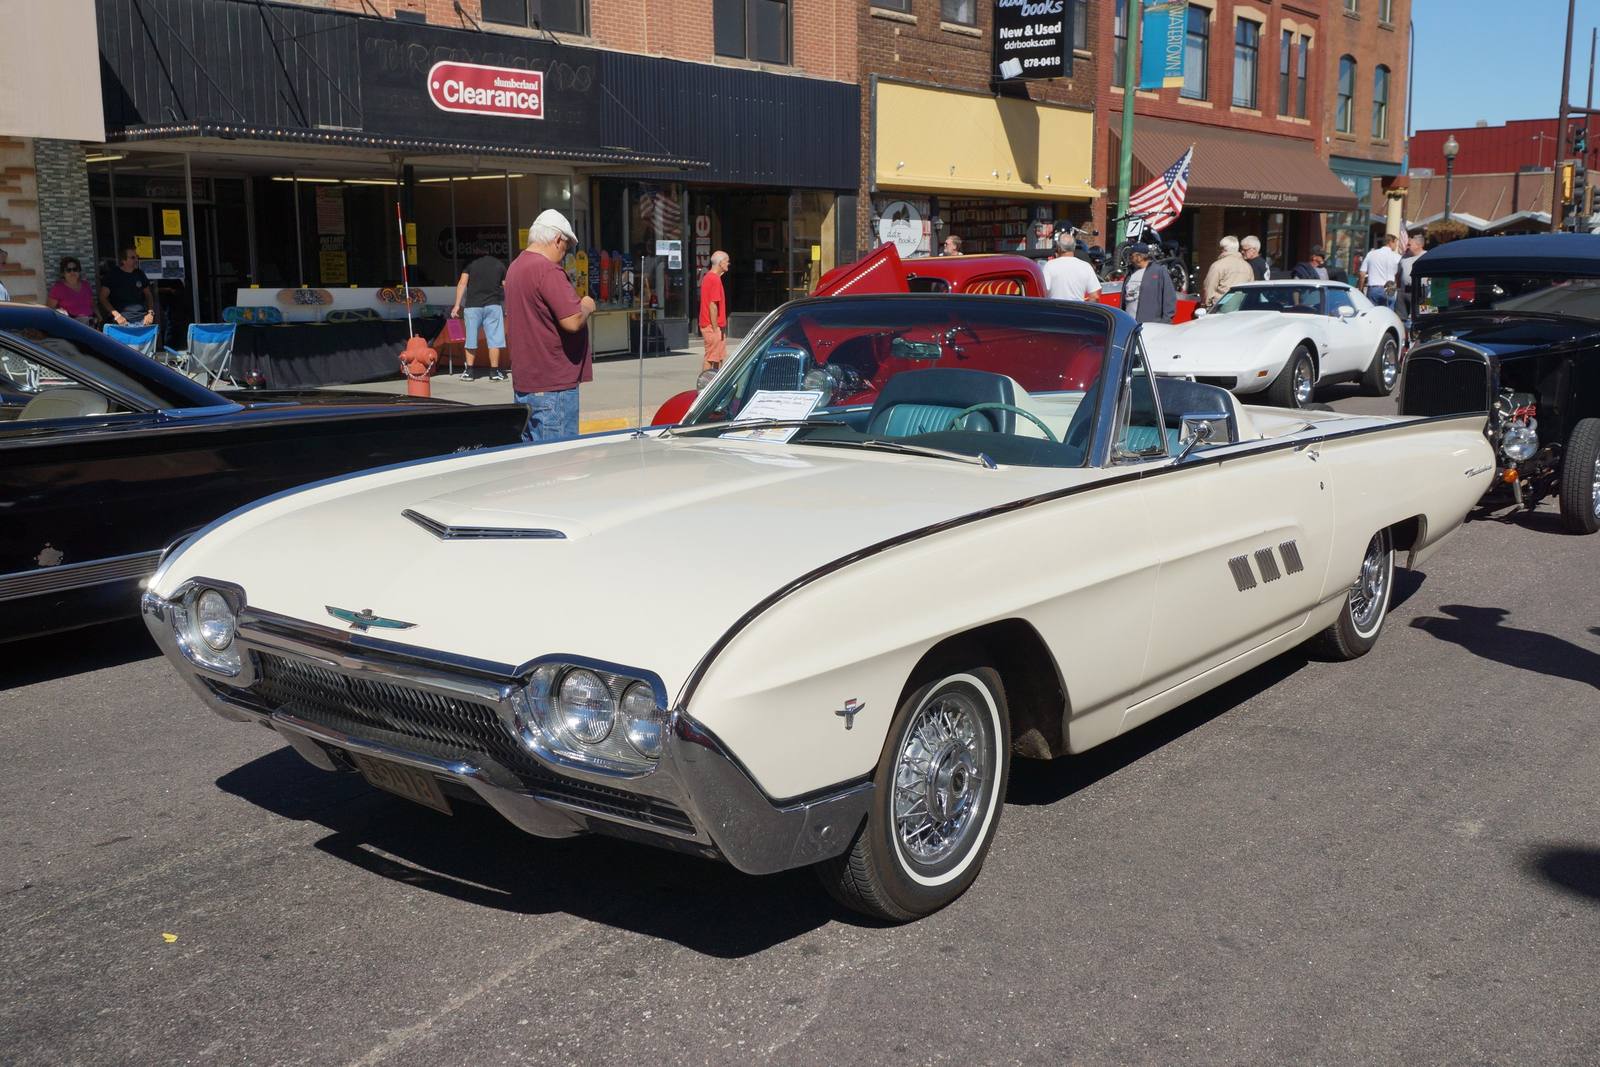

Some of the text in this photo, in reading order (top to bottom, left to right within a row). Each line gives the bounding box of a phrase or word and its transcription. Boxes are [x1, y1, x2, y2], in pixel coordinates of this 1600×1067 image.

[1021, 0, 1063, 16] books
[1000, 21, 1061, 39] New & Used
[1165, 4, 1184, 70] WATERTOWN
[1004, 39, 1055, 49] ddrbooks.com
[1024, 56, 1060, 67] 878-0418
[494, 76, 539, 90] slumberland
[443, 80, 539, 110] Clearance
